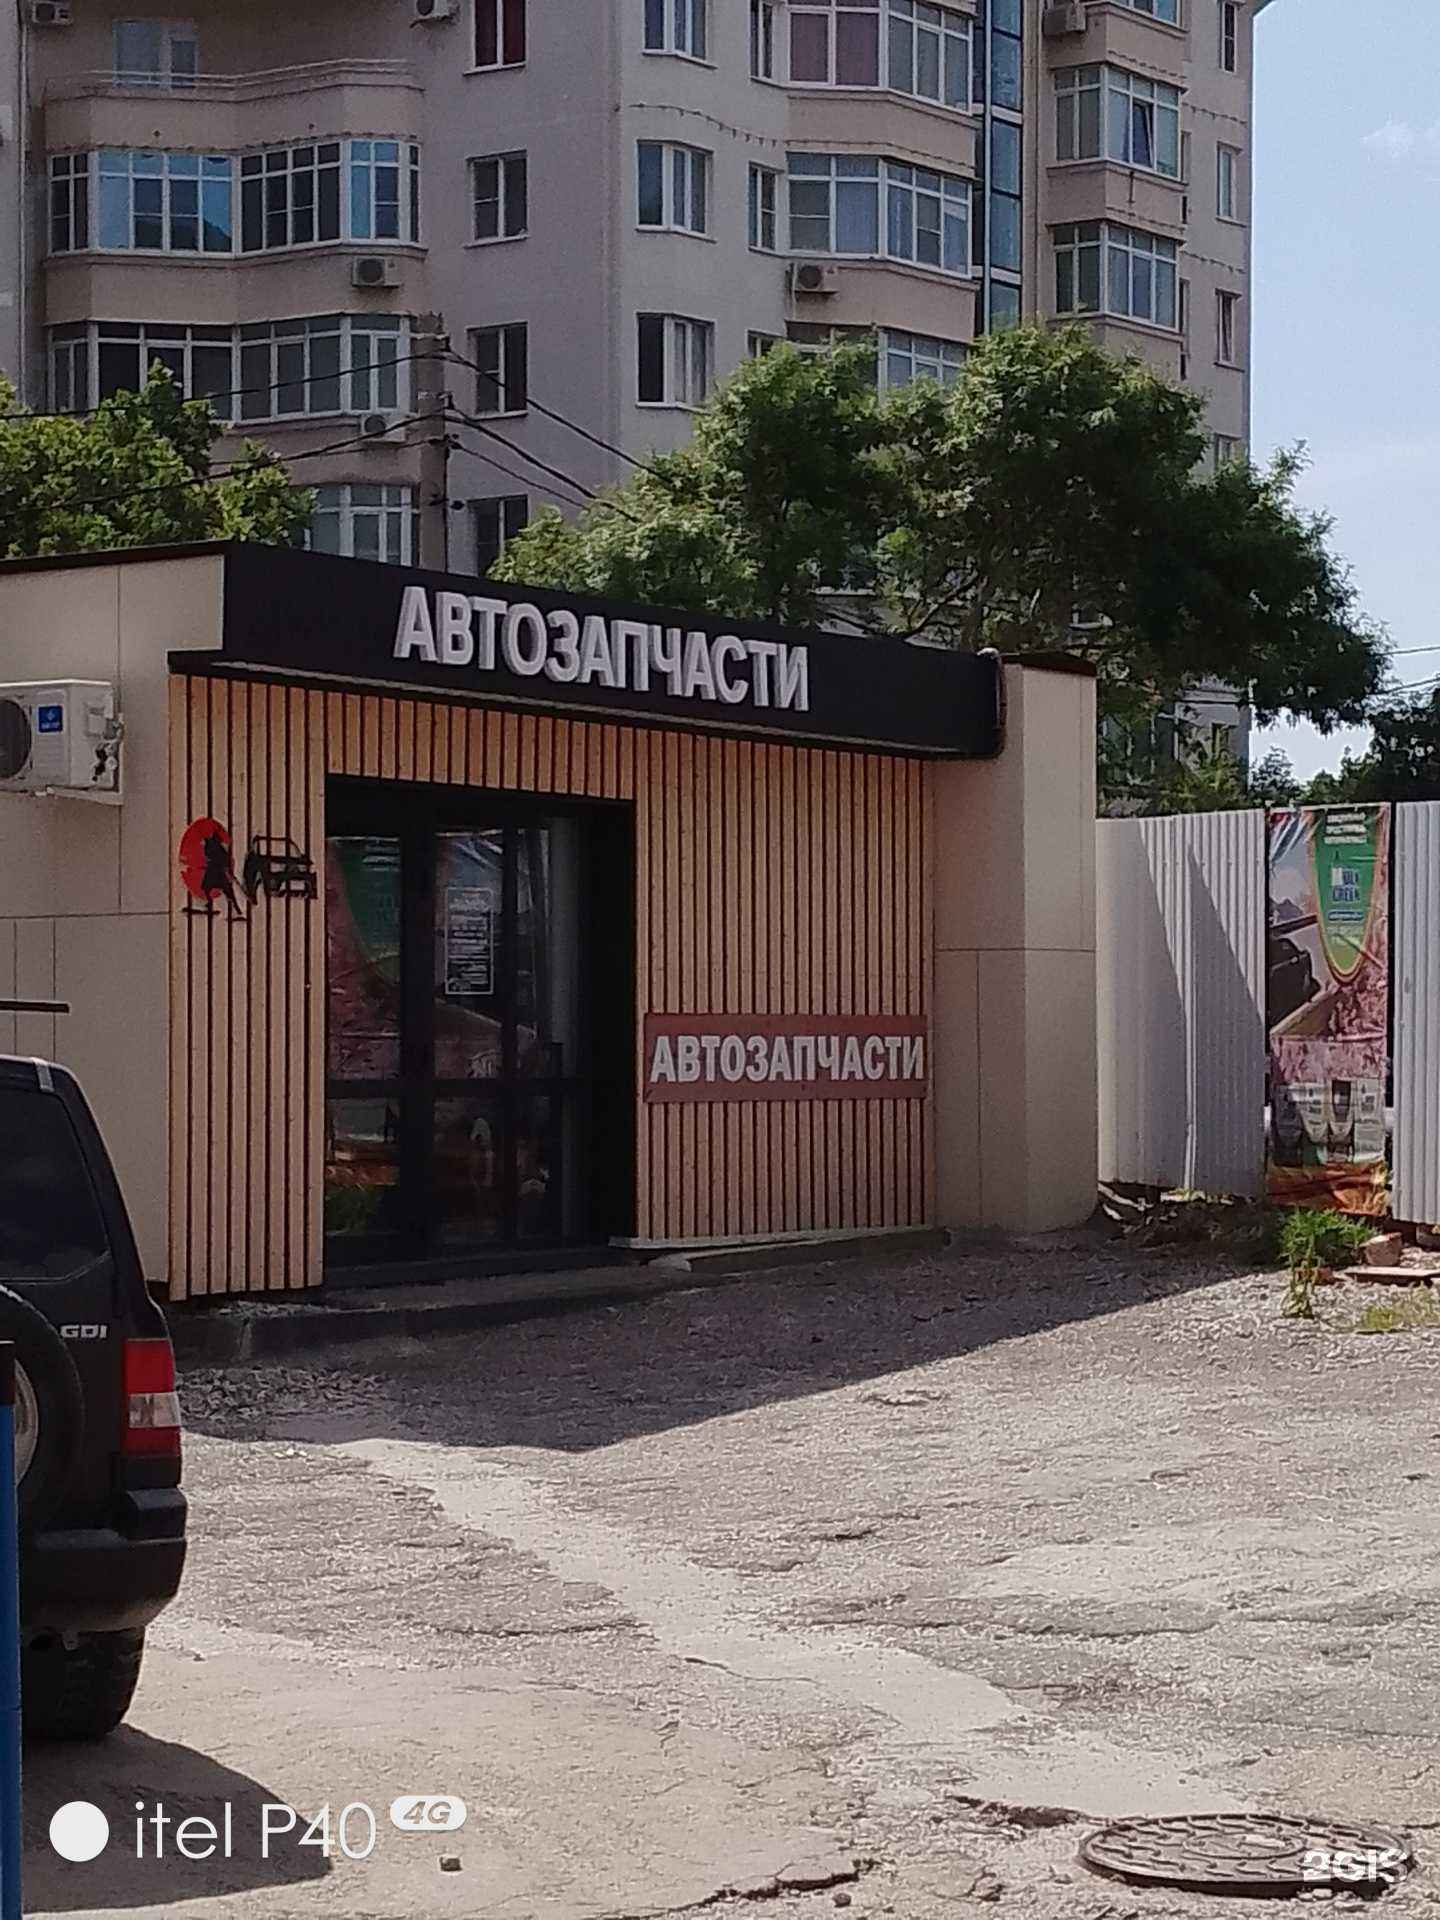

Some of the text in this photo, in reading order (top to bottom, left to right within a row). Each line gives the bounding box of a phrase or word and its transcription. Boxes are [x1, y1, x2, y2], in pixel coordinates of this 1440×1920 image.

[393, 586, 809, 711] АВТОЗАПЧАСТИ
[650, 1035, 923, 1082] АВТОЗАПЧАСТИ
[60, 1324, 107, 1338] GDI
